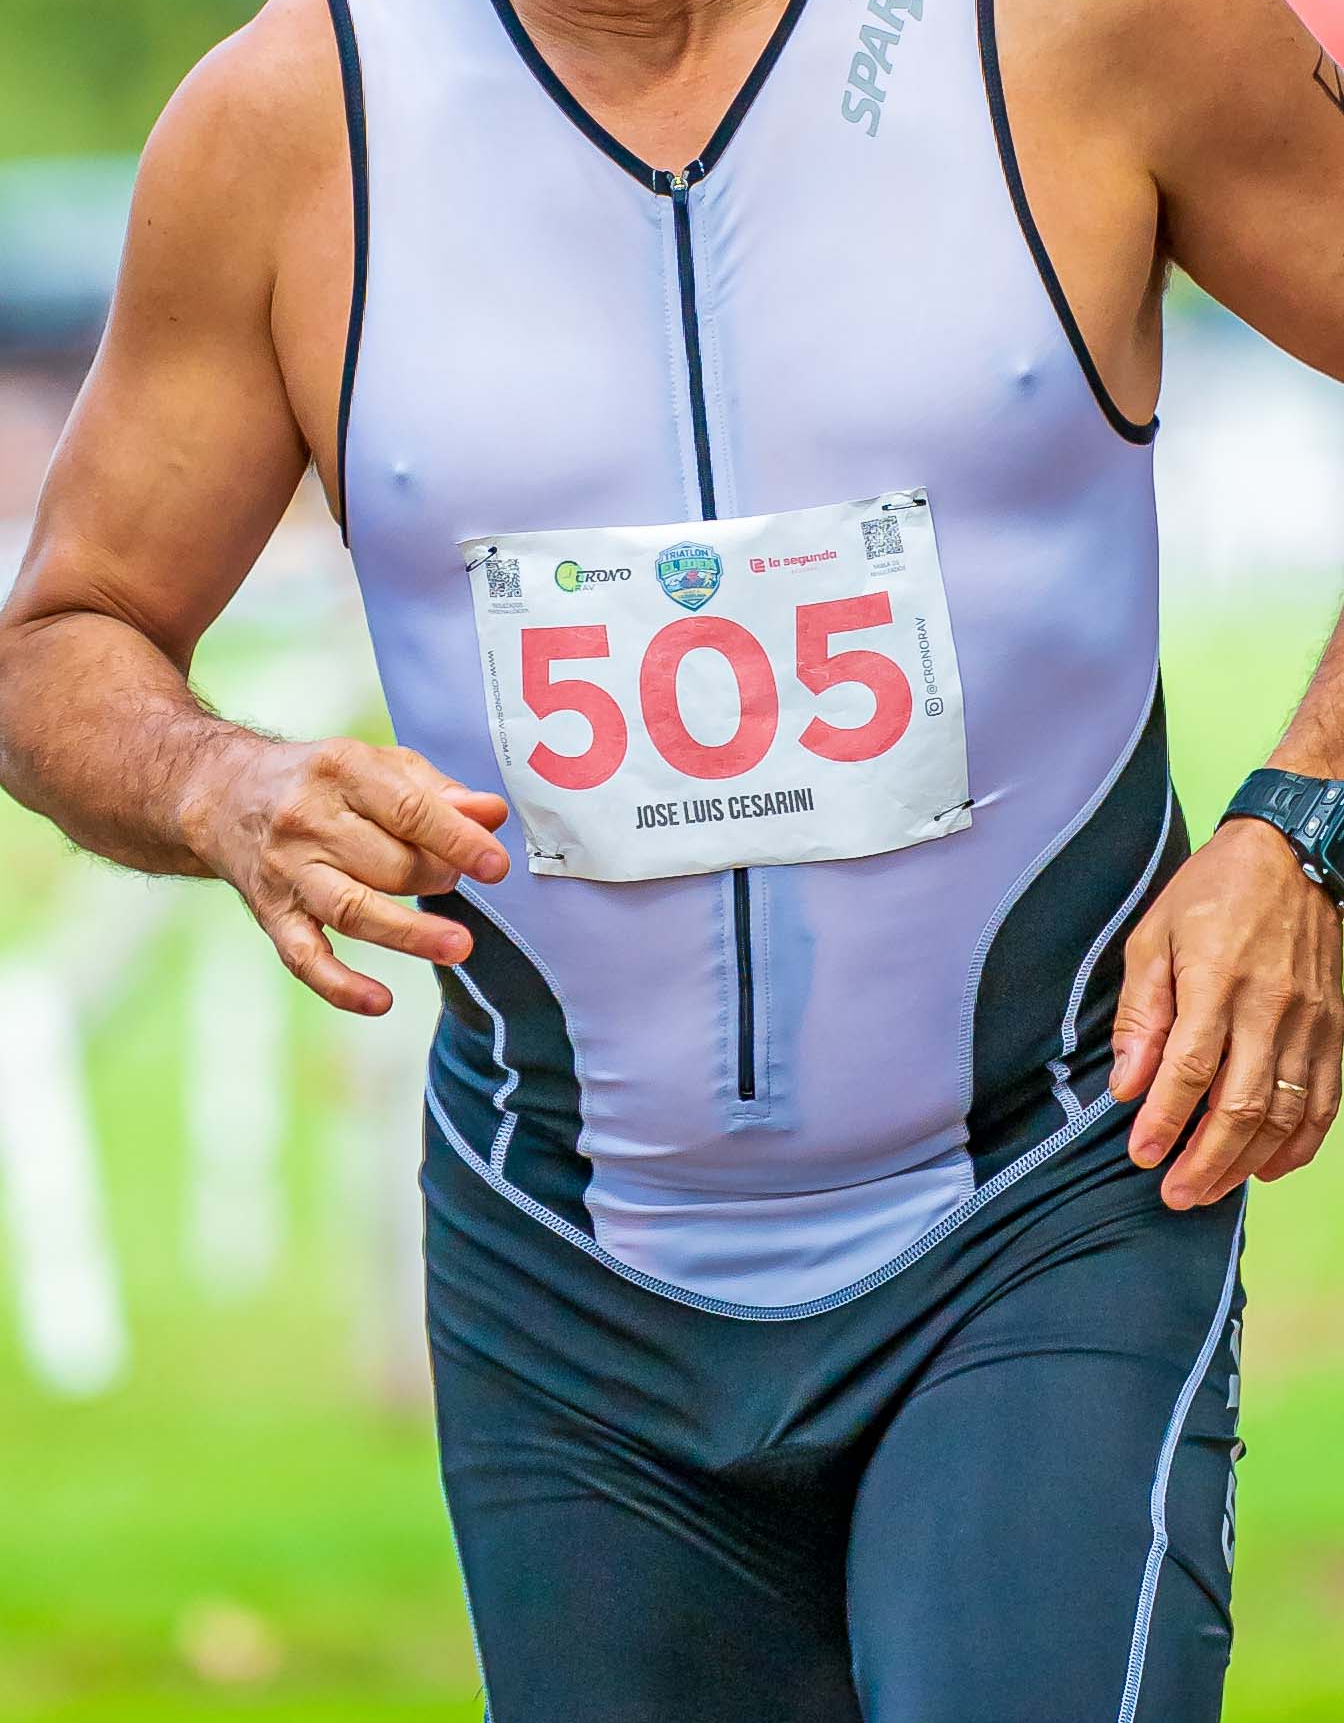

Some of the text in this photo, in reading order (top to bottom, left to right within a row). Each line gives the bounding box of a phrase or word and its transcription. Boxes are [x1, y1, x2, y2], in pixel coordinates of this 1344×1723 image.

[662, 548, 709, 561] TRIATLON
[768, 549, 838, 568] la segunda
[914, 616, 938, 695] @CRONORAV
[521, 591, 913, 791] 505
[636, 787, 815, 829] JOSE LUIS CESARINI
